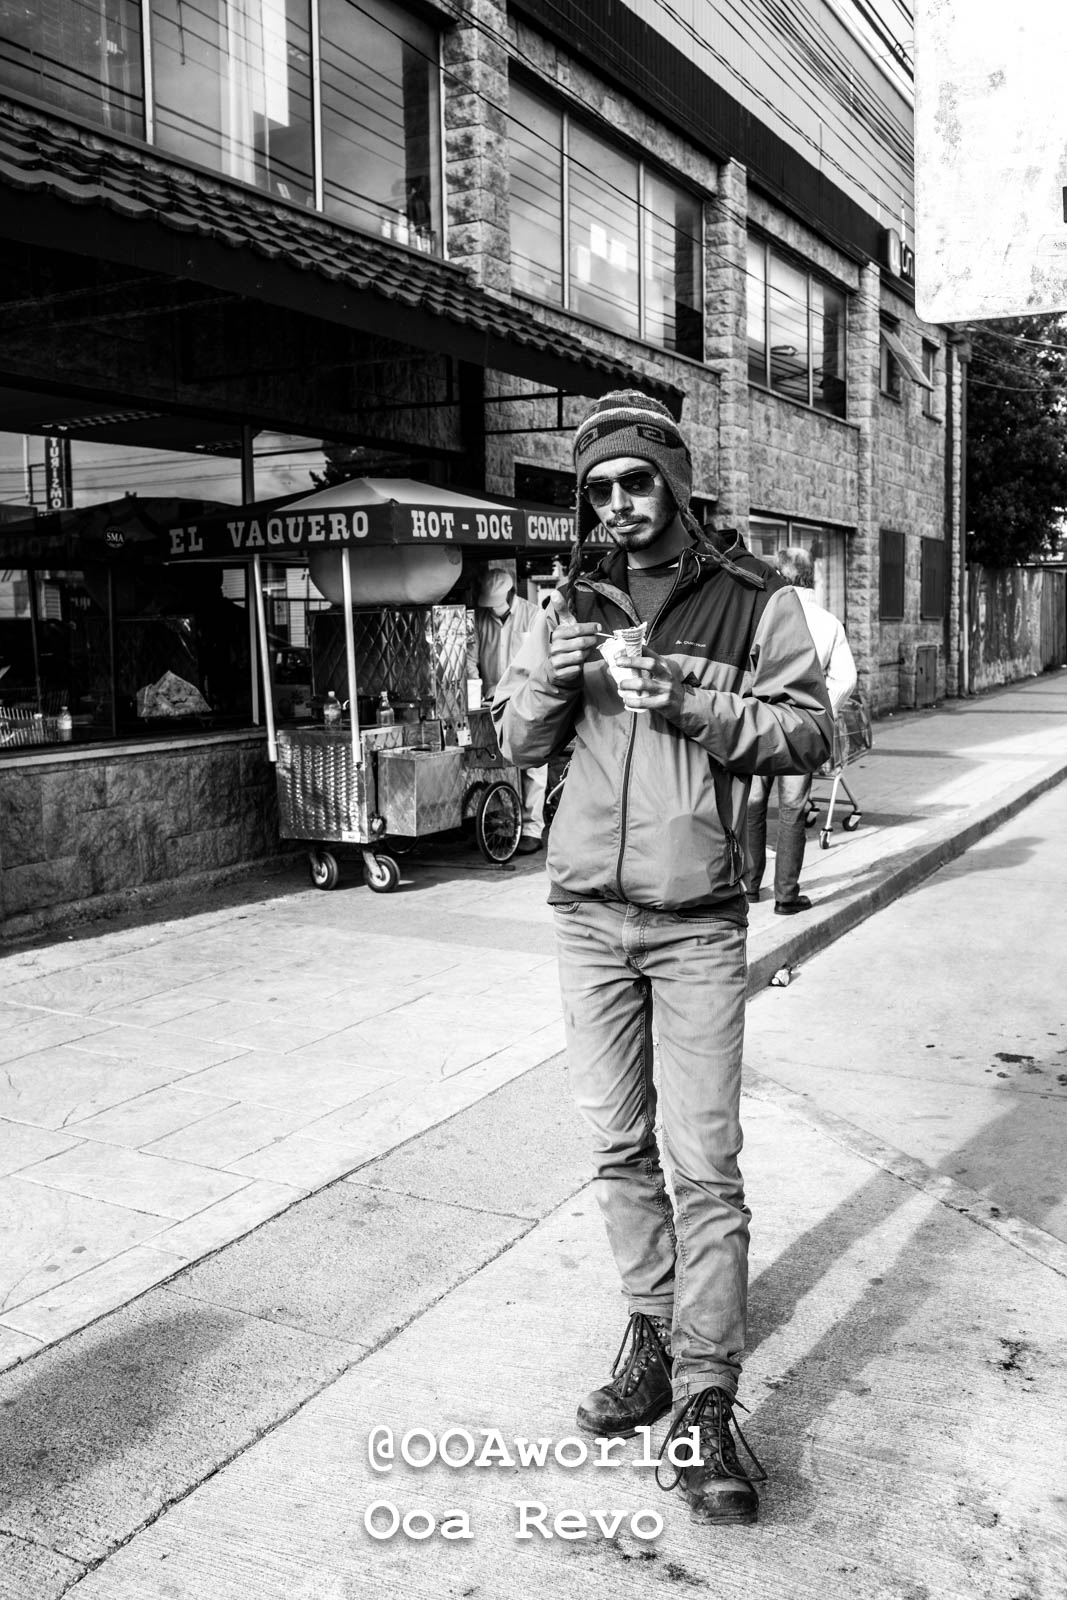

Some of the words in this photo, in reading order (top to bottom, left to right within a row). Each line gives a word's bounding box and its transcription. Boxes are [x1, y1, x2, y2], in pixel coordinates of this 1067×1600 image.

[169, 526, 204, 555] EL
[227, 510, 369, 549] VAQUERO
[410, 510, 454, 539] HOT
[476, 513, 514, 541] DOG
